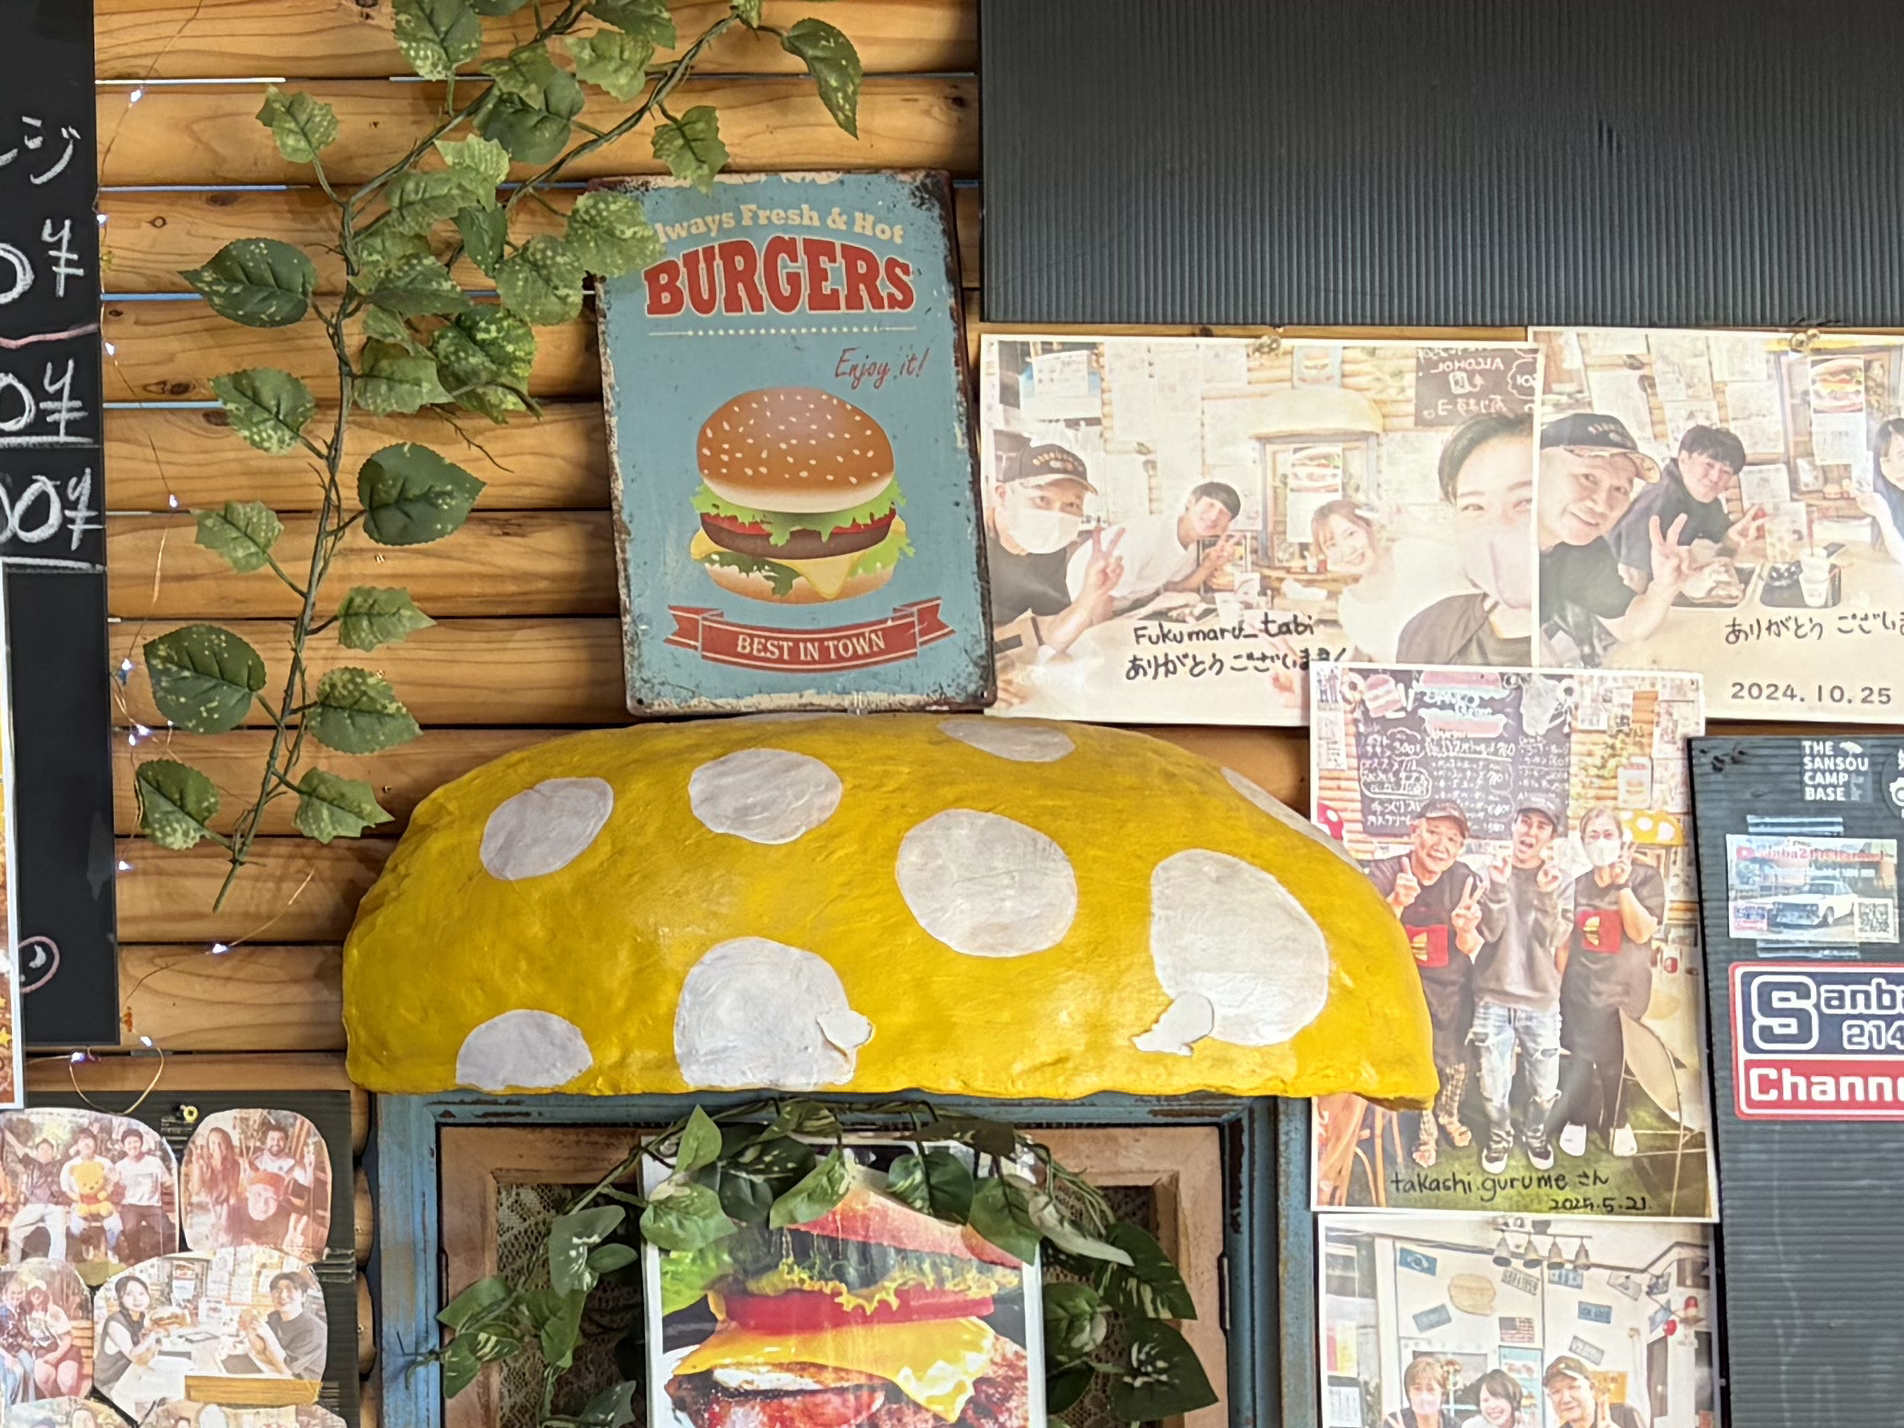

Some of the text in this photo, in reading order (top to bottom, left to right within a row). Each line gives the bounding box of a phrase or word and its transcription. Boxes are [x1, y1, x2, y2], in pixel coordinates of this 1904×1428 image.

[655, 203, 905, 245] lways Fresh & Hot
[643, 234, 917, 319] BURGERS
[835, 346, 931, 390] Enjoy it!
[1724, 612, 1825, 644] ありがとう
[736, 630, 887, 661] BEST IN TOWN
[1731, 681, 1894, 707] 2024.10.25
[1802, 740, 1834, 756] THE
[1804, 755, 1869, 771] SANSOU
[1804, 772, 1849, 786] CAMP
[1804, 787, 1845, 801] BASE
